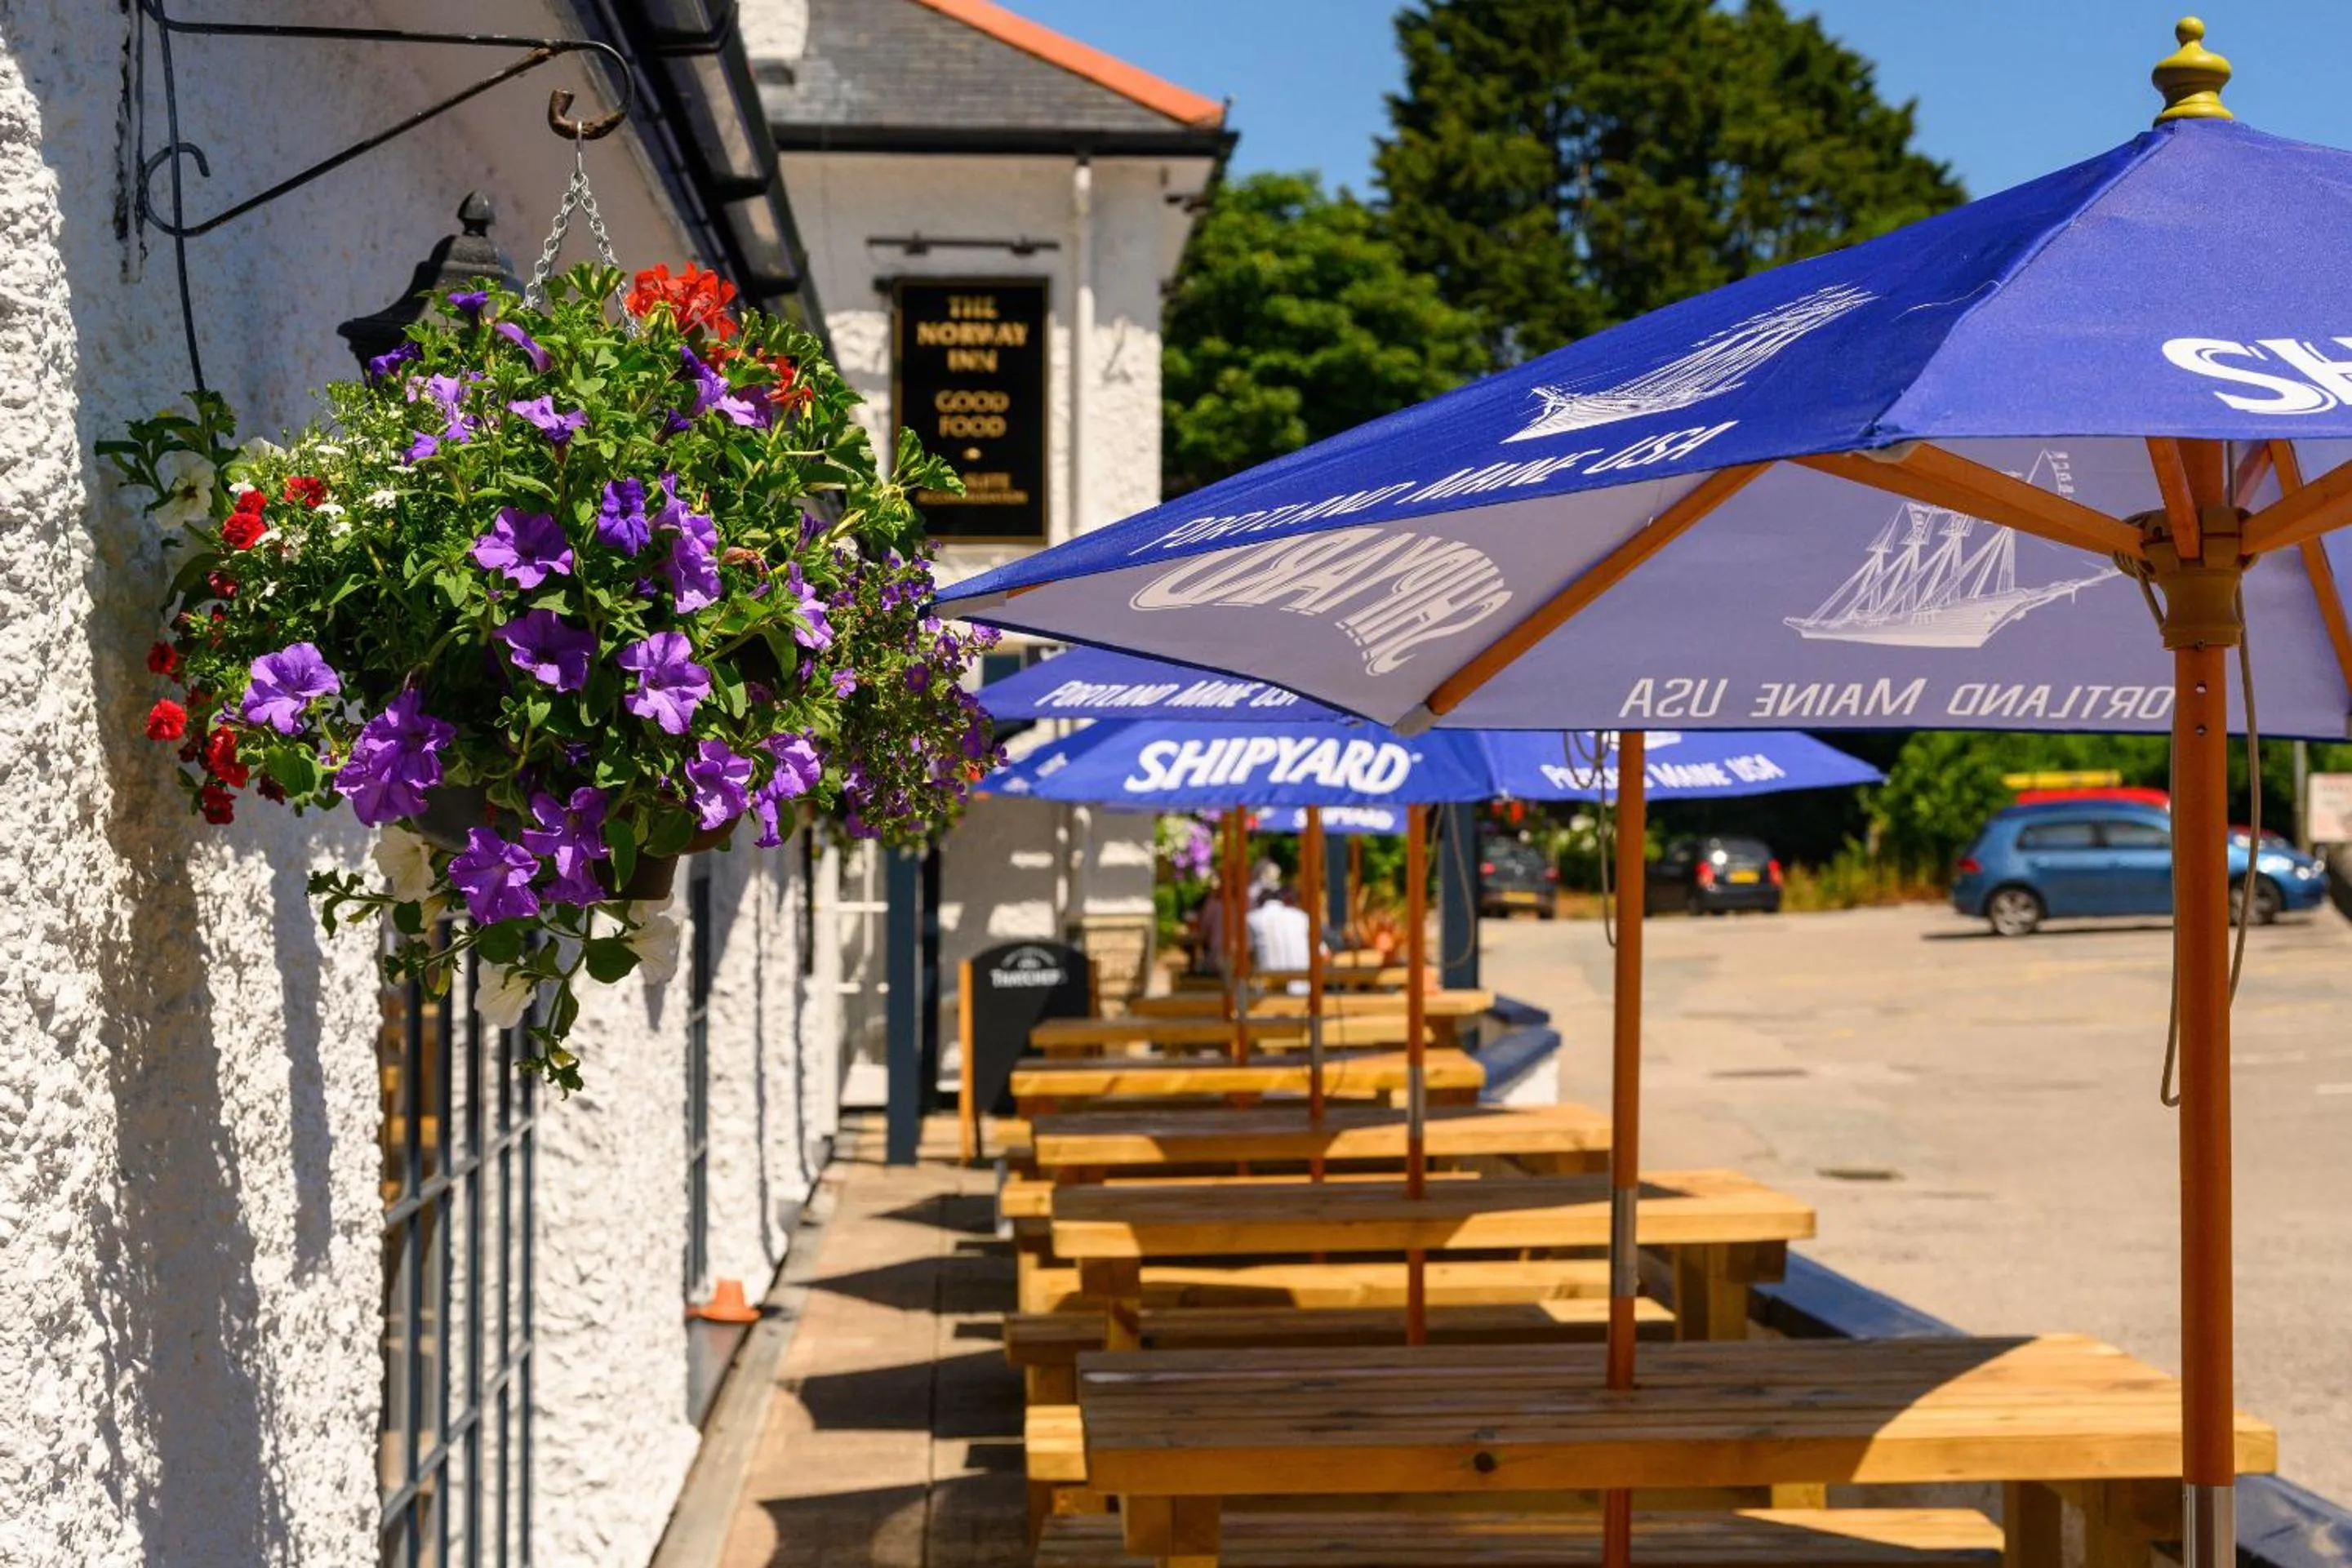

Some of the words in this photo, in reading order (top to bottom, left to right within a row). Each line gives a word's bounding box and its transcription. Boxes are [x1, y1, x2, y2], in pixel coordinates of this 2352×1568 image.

[949, 295, 998, 318] THE
[947, 349, 998, 372] INN
[935, 390, 1010, 412] GOOD
[939, 415, 1006, 438] FOOD
[1128, 481, 1416, 555] PORTLAND
[1394, 448, 1603, 505] MAINE
[1582, 420, 1740, 474] USA
[1123, 736, 1412, 794] SHIPYARD
[1724, 753, 1785, 782] USA
